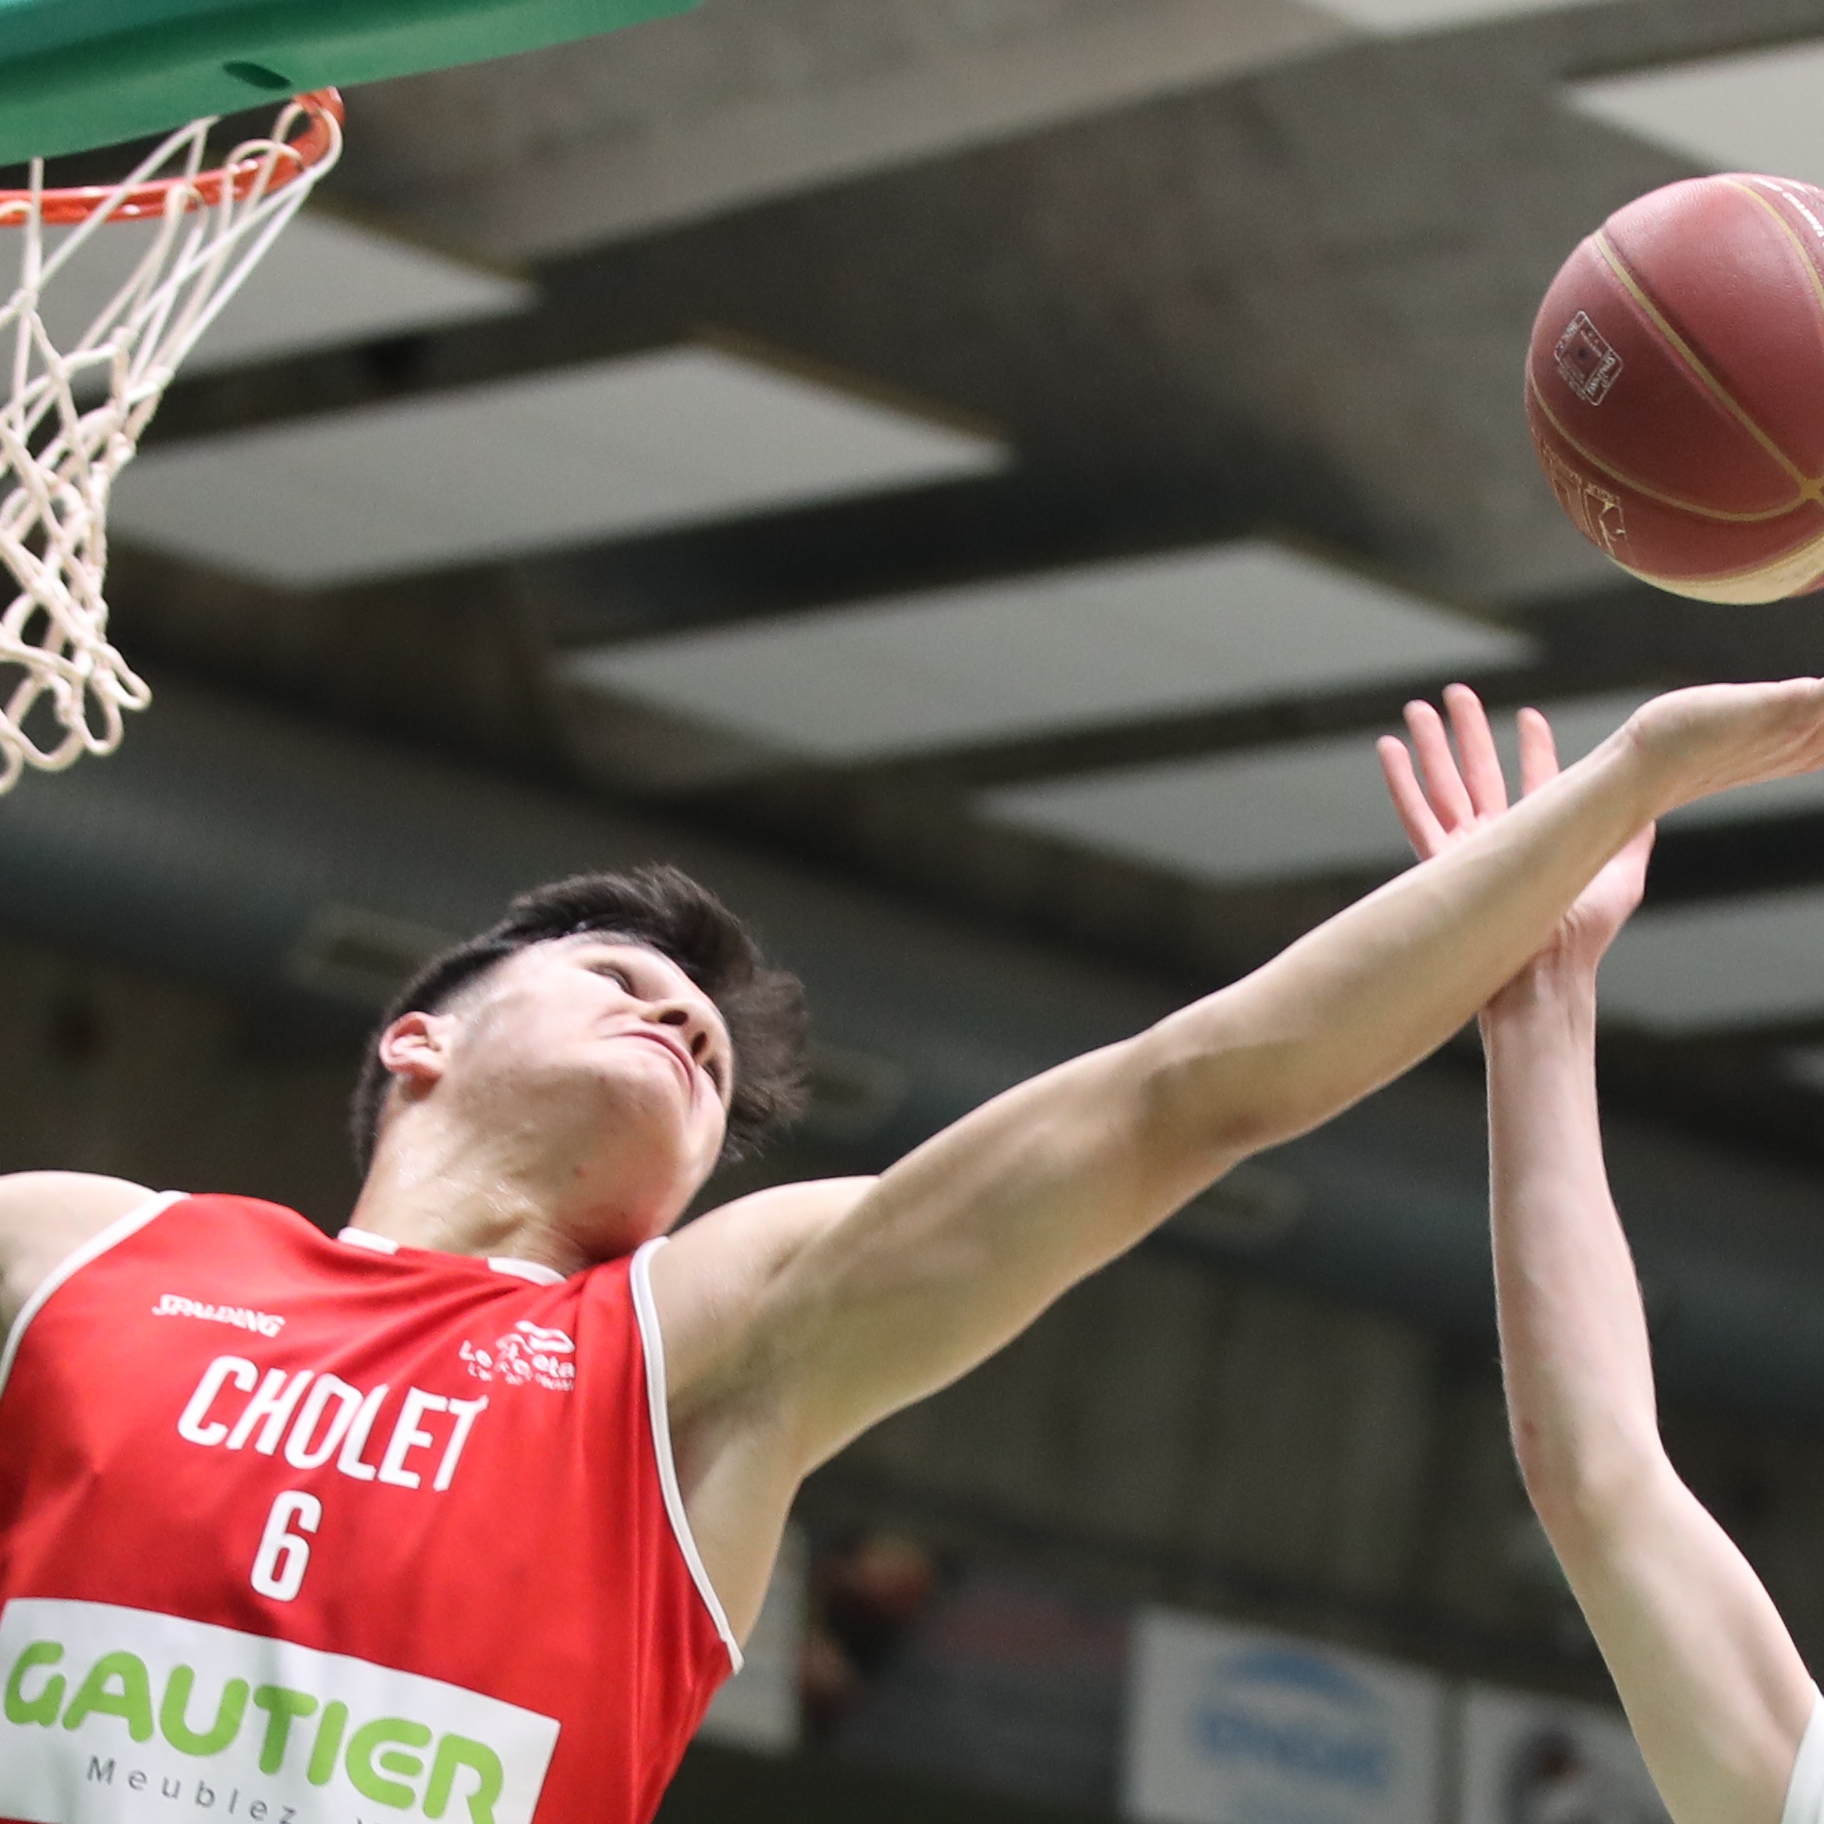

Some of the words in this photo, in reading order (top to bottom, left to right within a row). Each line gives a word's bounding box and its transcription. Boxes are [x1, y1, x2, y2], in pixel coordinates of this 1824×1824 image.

[151, 1293, 287, 1338] SPALDING
[177, 1354, 491, 1493] CHOLET
[249, 1488, 324, 1602] 6
